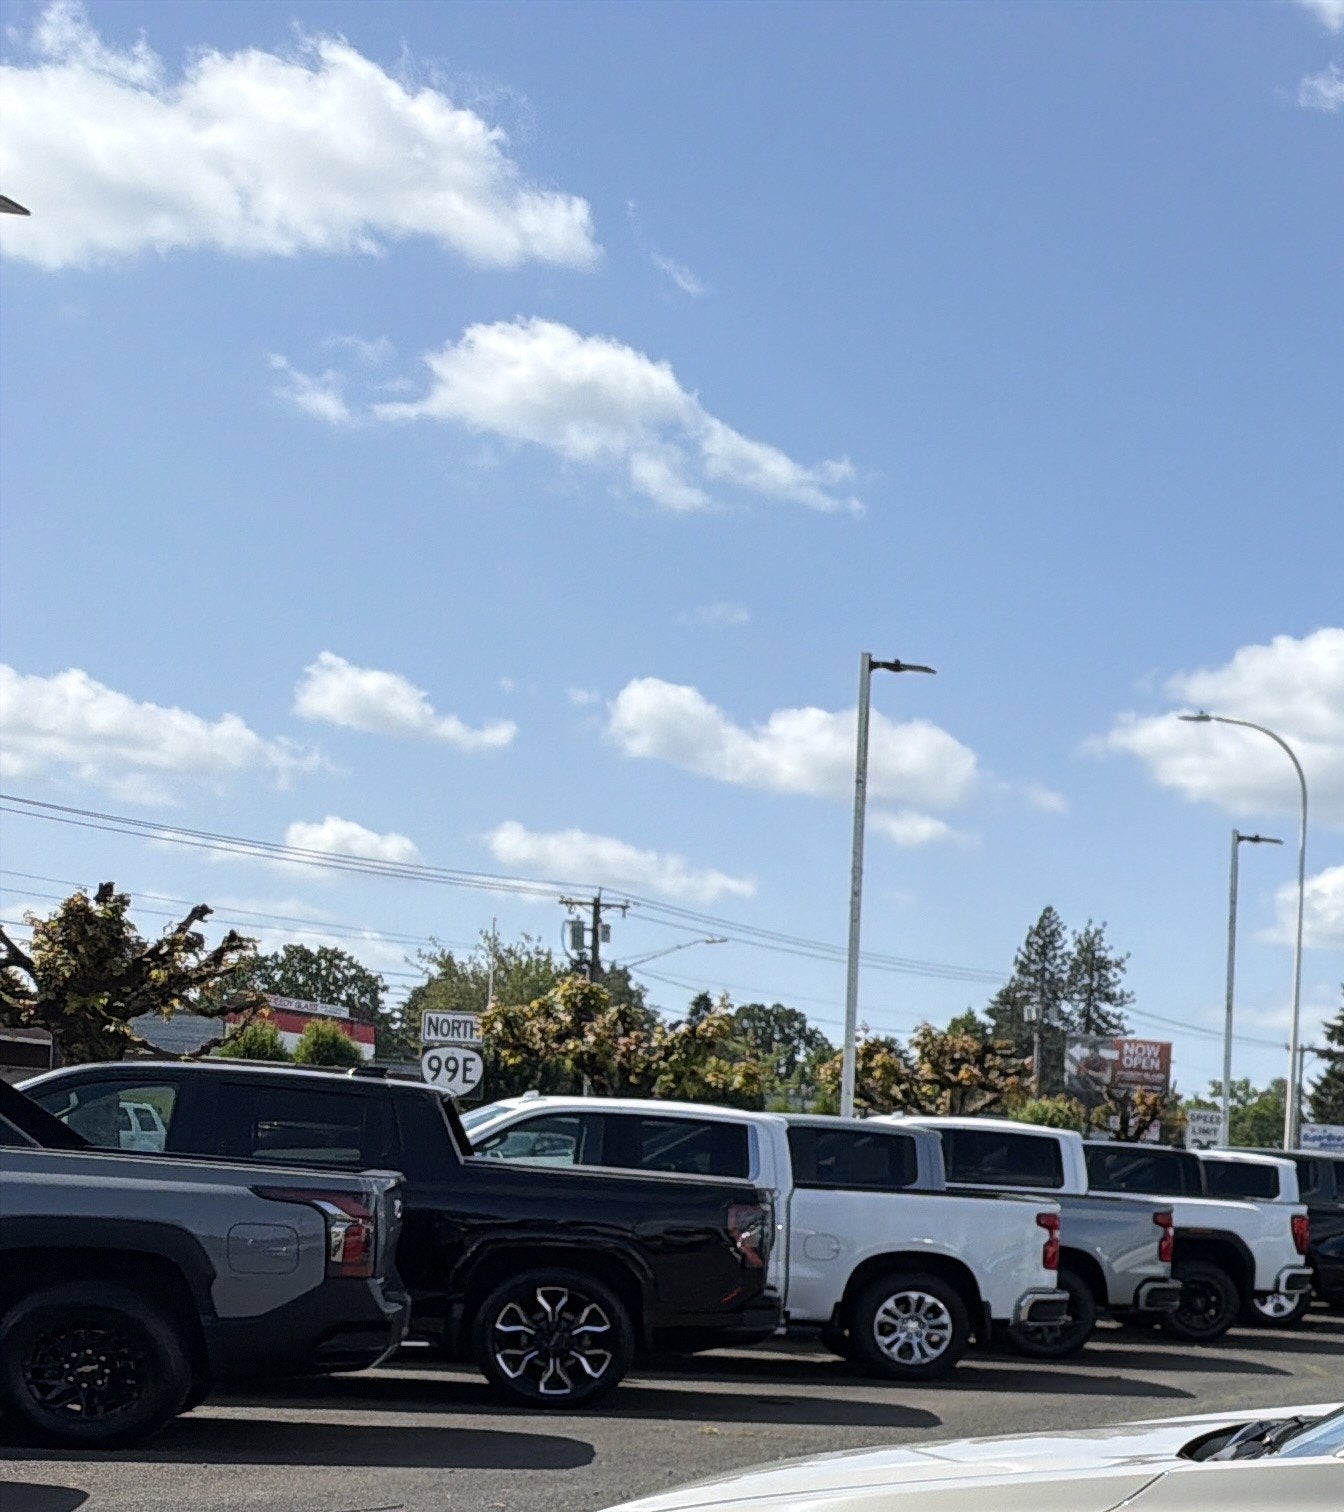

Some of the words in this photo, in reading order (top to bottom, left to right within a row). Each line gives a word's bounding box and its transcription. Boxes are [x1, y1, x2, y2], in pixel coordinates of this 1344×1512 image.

[427, 1016, 480, 1039] NORTH
[1123, 1043, 1160, 1057] NOW
[427, 1055, 476, 1084] 99E
[1122, 1056, 1160, 1070] OPEN
[1190, 1112, 1222, 1125] SPEED
[1191, 1126, 1218, 1137] LIMIT
